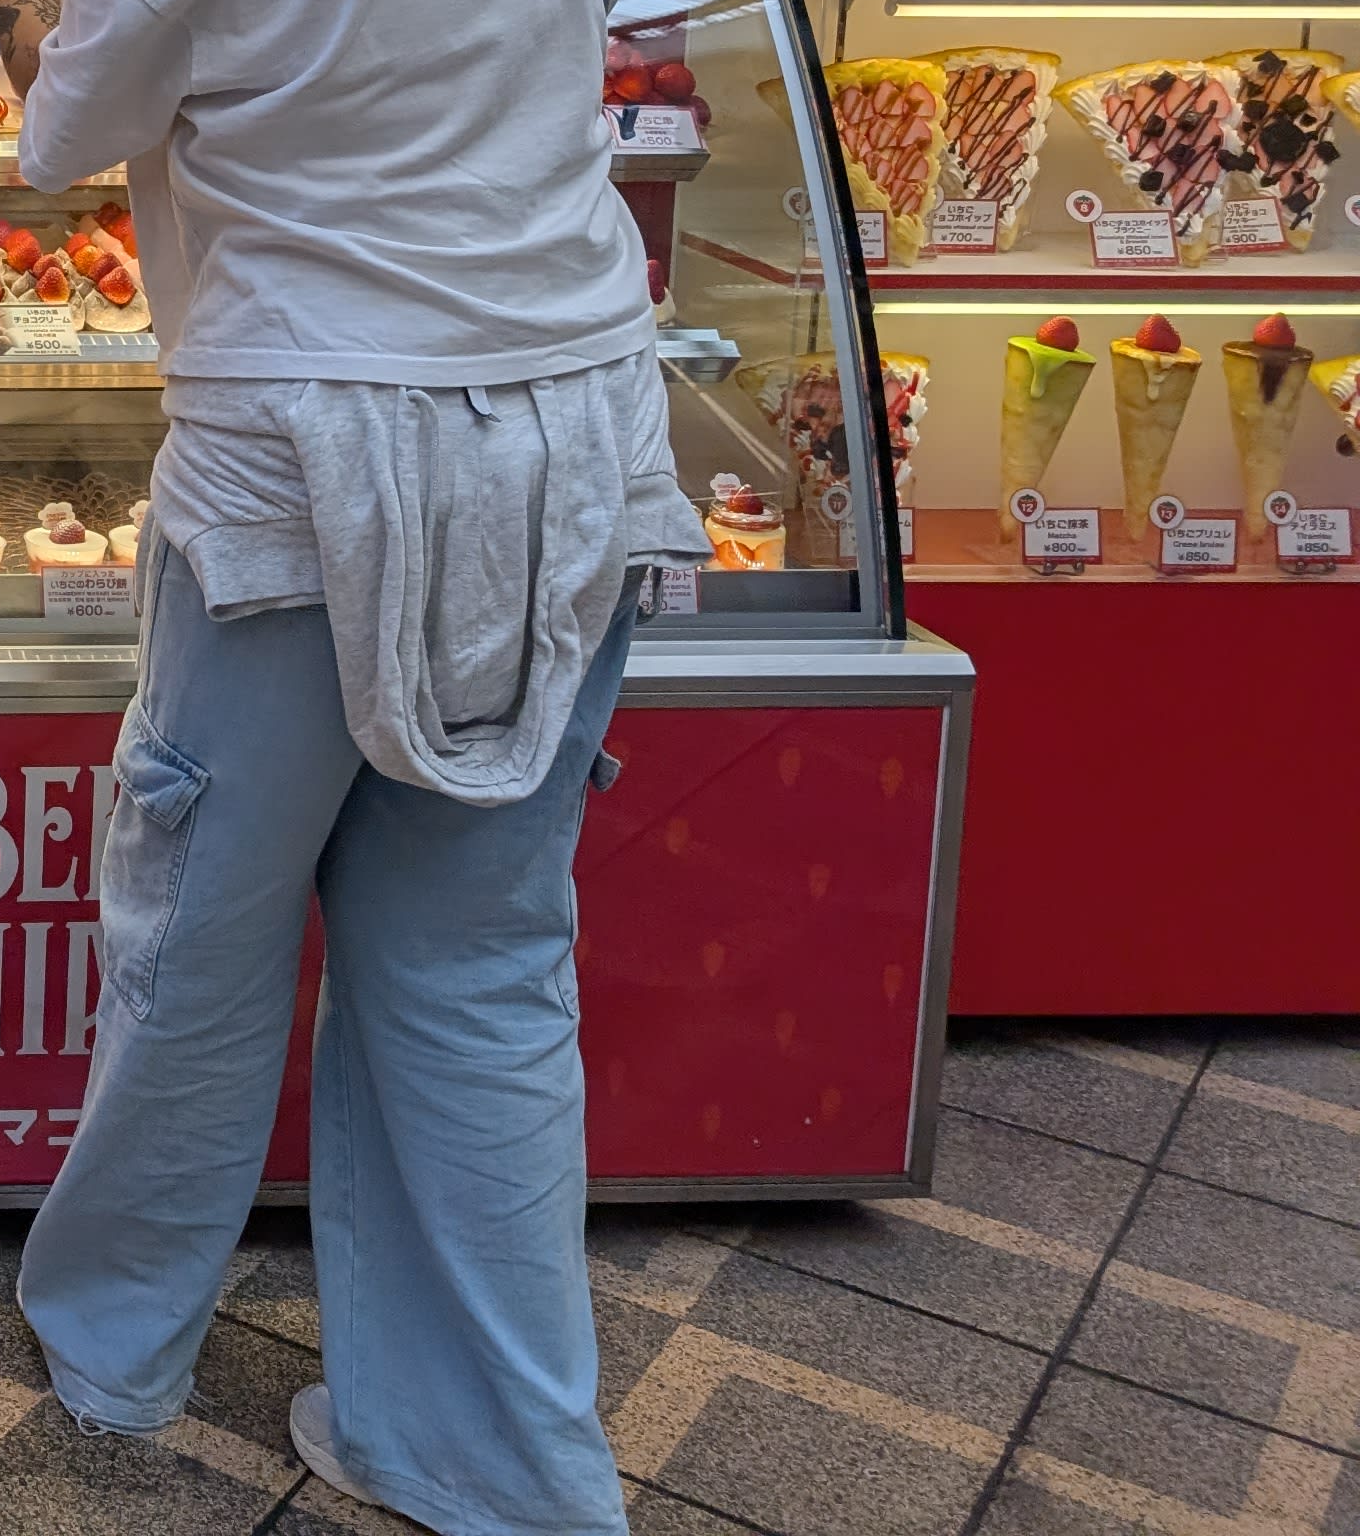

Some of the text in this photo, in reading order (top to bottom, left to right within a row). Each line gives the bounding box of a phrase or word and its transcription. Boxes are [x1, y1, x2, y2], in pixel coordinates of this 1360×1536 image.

[14, 316, 71, 324] チョコクリーム
[67, 605, 103, 616] ¥600
